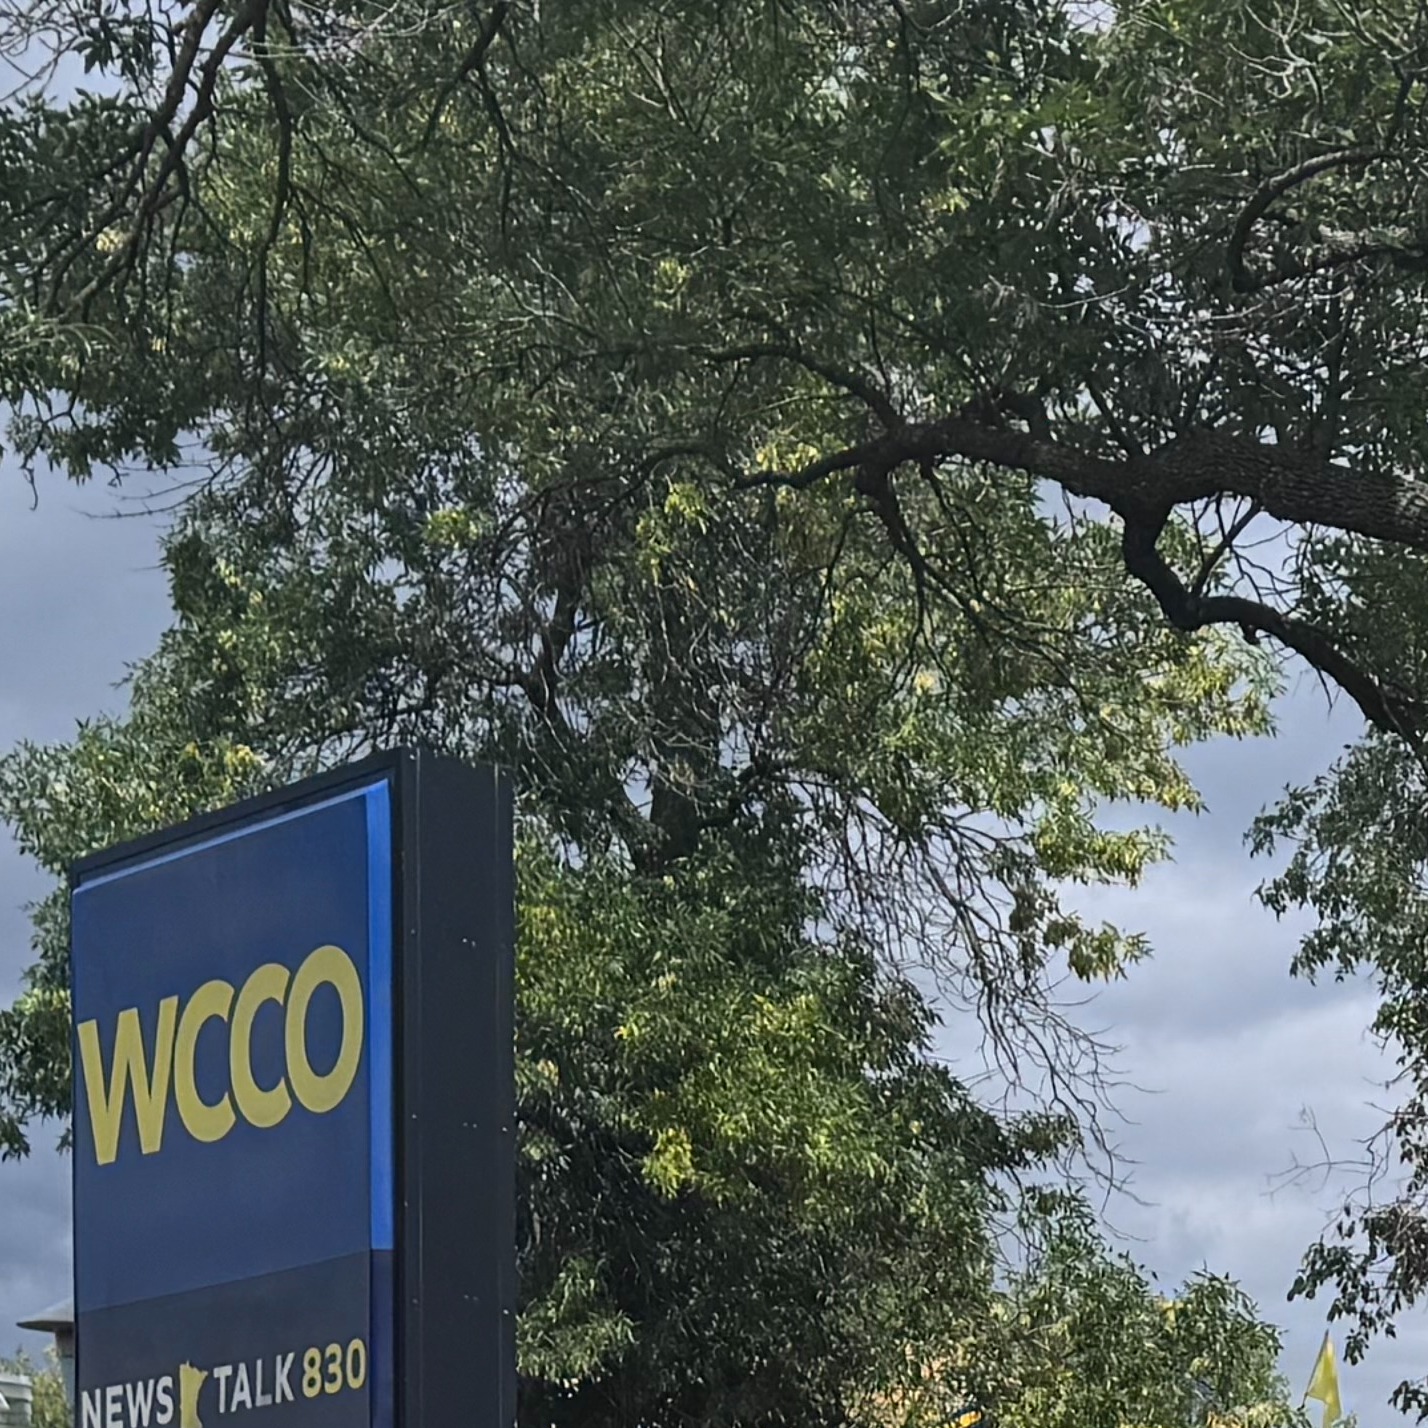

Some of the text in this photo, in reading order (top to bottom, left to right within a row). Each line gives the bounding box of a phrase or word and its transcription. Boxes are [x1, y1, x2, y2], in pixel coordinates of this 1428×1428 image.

[77, 944, 364, 1166] WCCO
[213, 1351, 296, 1412] TALK
[301, 1338, 367, 1398] 830
